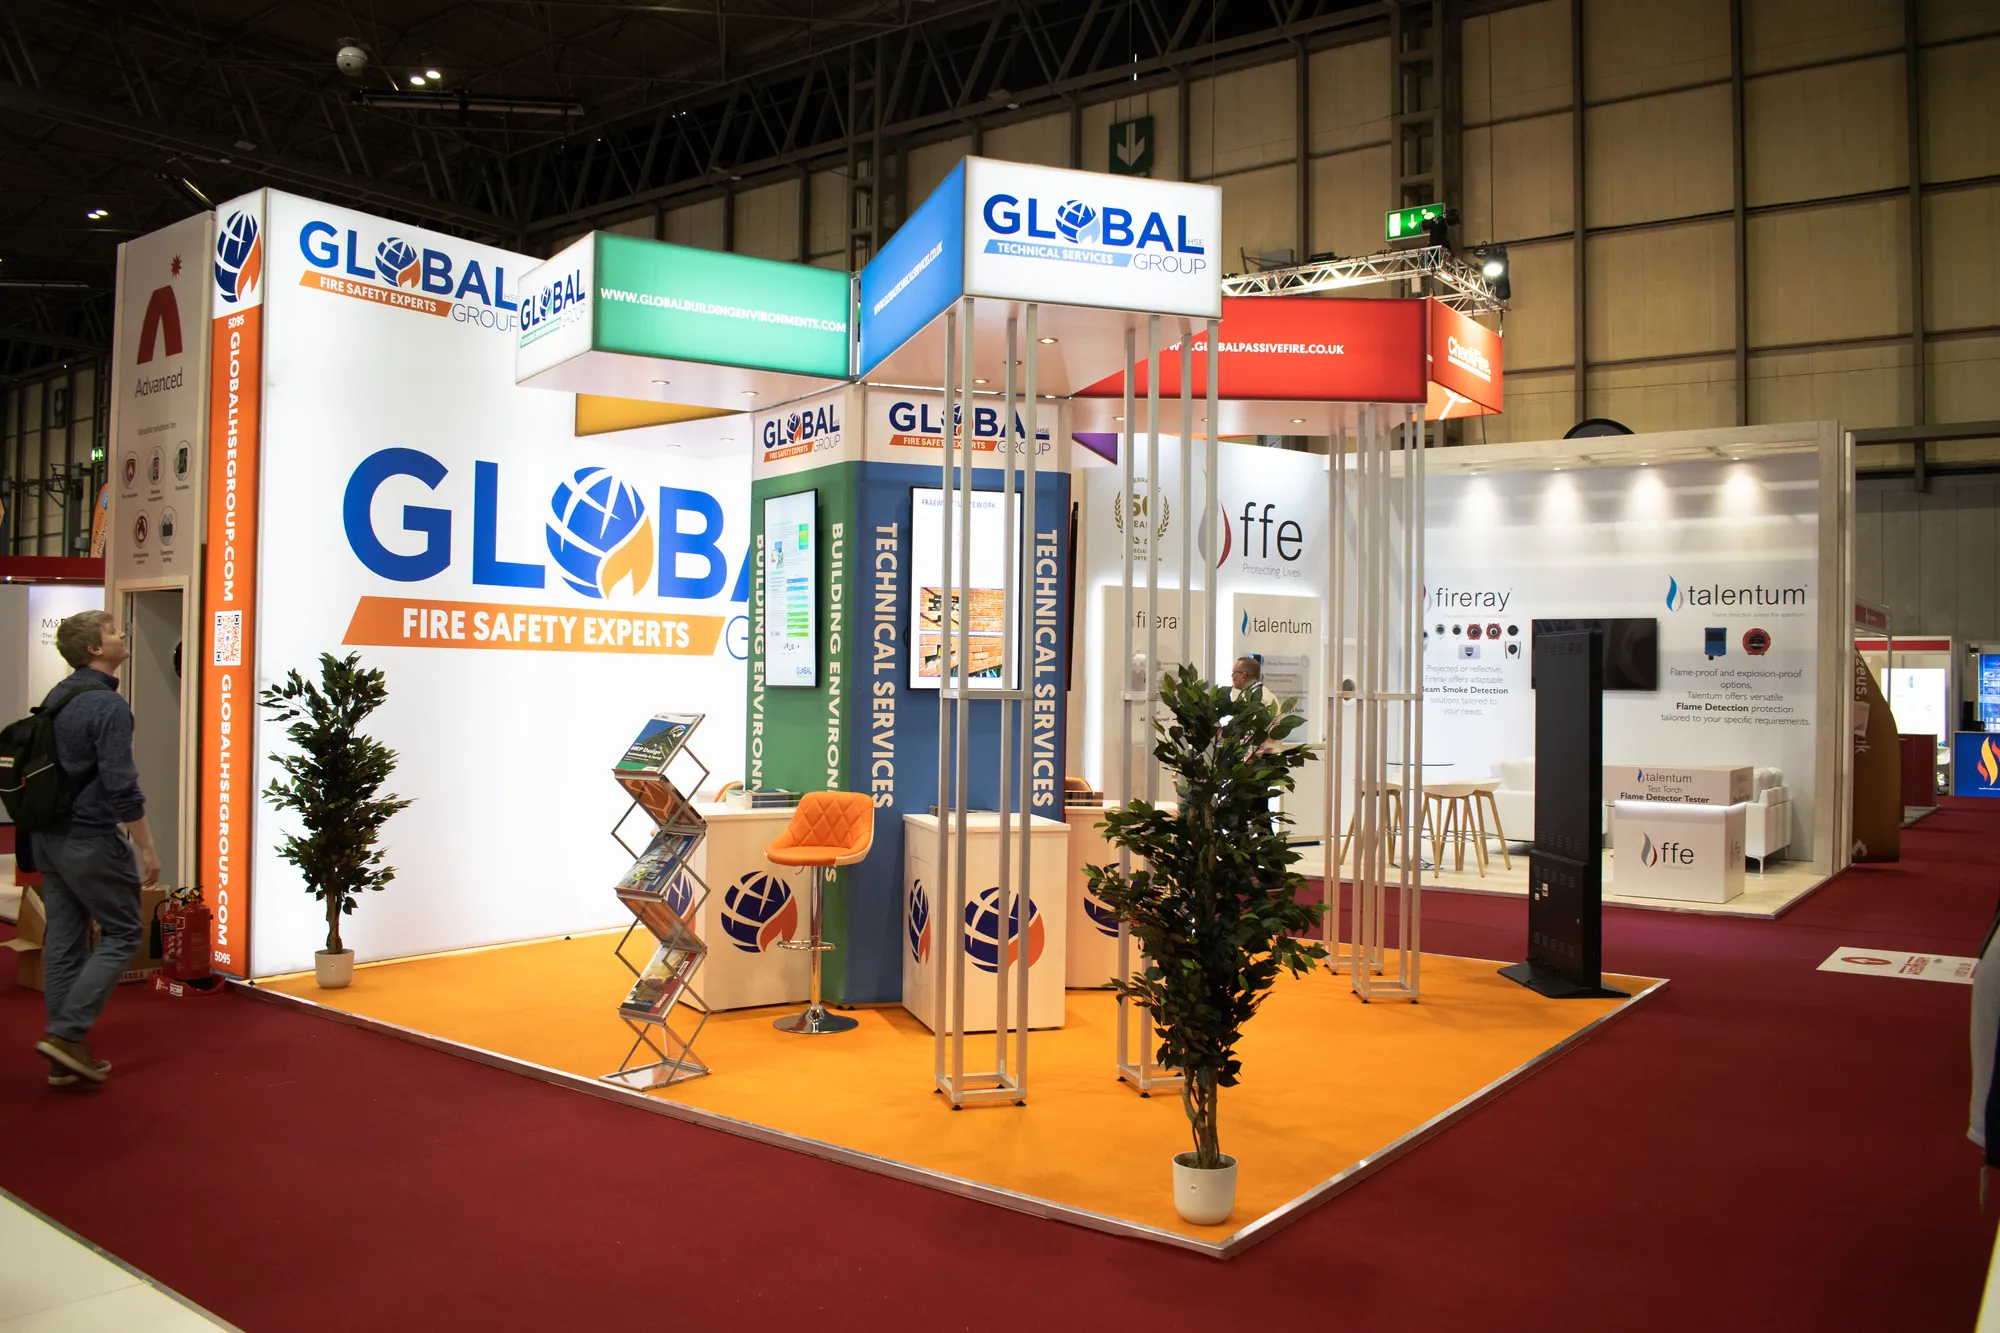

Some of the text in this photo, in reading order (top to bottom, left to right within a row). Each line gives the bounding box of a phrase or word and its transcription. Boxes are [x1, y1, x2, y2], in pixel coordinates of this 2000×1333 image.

[983, 194, 1204, 255] GLOBAL
[1188, 238, 1204, 247] HSE
[997, 242, 1113, 265] TECHNICAL SERVICES
[1133, 253, 1206, 275] GROUP
[299, 221, 517, 311] GLOBAL
[319, 276, 437, 312] FIRE SAFETY EXPERTS
[520, 268, 585, 331] GLOBAL
[228, 314, 245, 329] 5D95
[600, 288, 847, 334] WWW.GLOBALBUILDINGENVIRONMENTS.COM
[135, 367, 183, 398] Advanced
[763, 404, 840, 449] GLOBAL
[813, 433, 841, 453] GROUP
[903, 436, 986, 449] FIRE SAFET EXRTS
[223, 331, 241, 602] GLOBALHSEGROUP.COM
[1240, 501, 1303, 561] ffe
[1243, 563, 1302, 579] Protecting Lives
[829, 522, 844, 655] BUILDING
[1688, 584, 1806, 606] talentum
[1436, 588, 1510, 612] fireray
[403, 607, 465, 641] FIRE
[473, 611, 578, 645] SAFETY
[583, 616, 690, 649] EXPERTS
[1254, 617, 1312, 635] talentum
[871, 523, 898, 809] TECHNICAL SERVICES
[1032, 530, 1058, 807] TECHNICAL SERVICES
[1426, 665, 1459, 674] Projected
[1670, 667, 1803, 680] Flame-proof and explosion-proof
[1425, 675, 1504, 686] Fireray offers adaptable
[1443, 686, 1468, 694] Smoke
[1470, 686, 1509, 695] Detection
[1720, 681, 1752, 690] options.
[1430, 696, 1460, 704] solutions
[1461, 697, 1488, 705] tailored
[1687, 691, 1784, 702] Talentum offers versatile
[1443, 707, 1459, 716] your
[1676, 702, 1794, 715] Flame Detection protection
[752, 661, 764, 791] ENVIRON
[1661, 714, 1811, 727] tailored to your specific requirements.
[1646, 772, 1692, 784] talentum
[1620, 792, 1710, 804] Flame Detector Tester
[1647, 785, 1683, 794] Test Torch
[217, 673, 232, 947] GLOBALHSEGROUP.COM
[1661, 842, 1695, 864] ffe
[214, 950, 231, 965] 5D95
